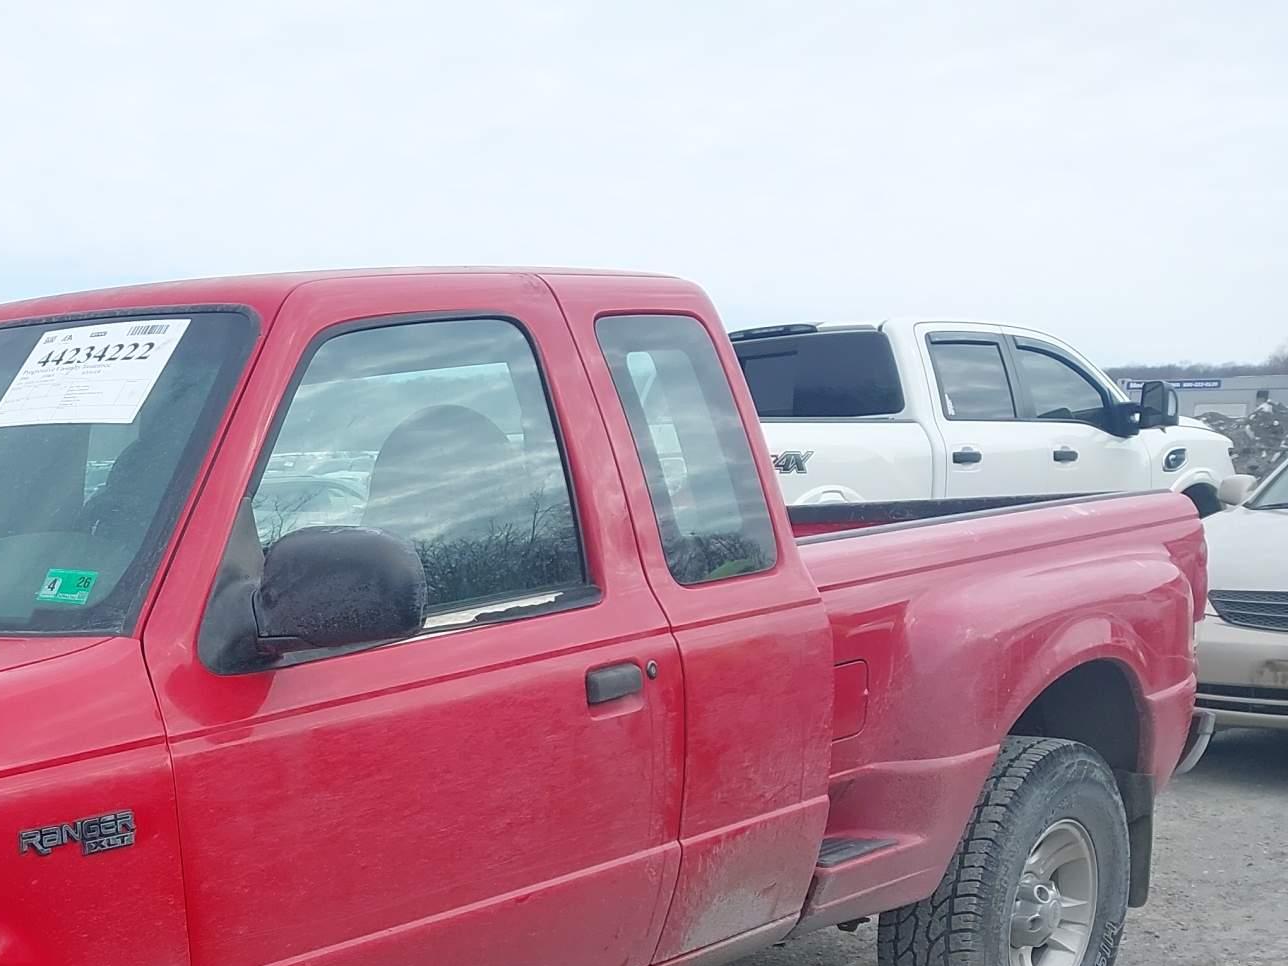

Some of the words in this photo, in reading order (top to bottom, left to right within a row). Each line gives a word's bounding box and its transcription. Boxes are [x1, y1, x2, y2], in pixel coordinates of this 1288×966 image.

[37, 341, 155, 367] 44234222
[47, 578, 58, 592] 4
[76, 576, 92, 589] 26
[87, 832, 132, 852] XLT
